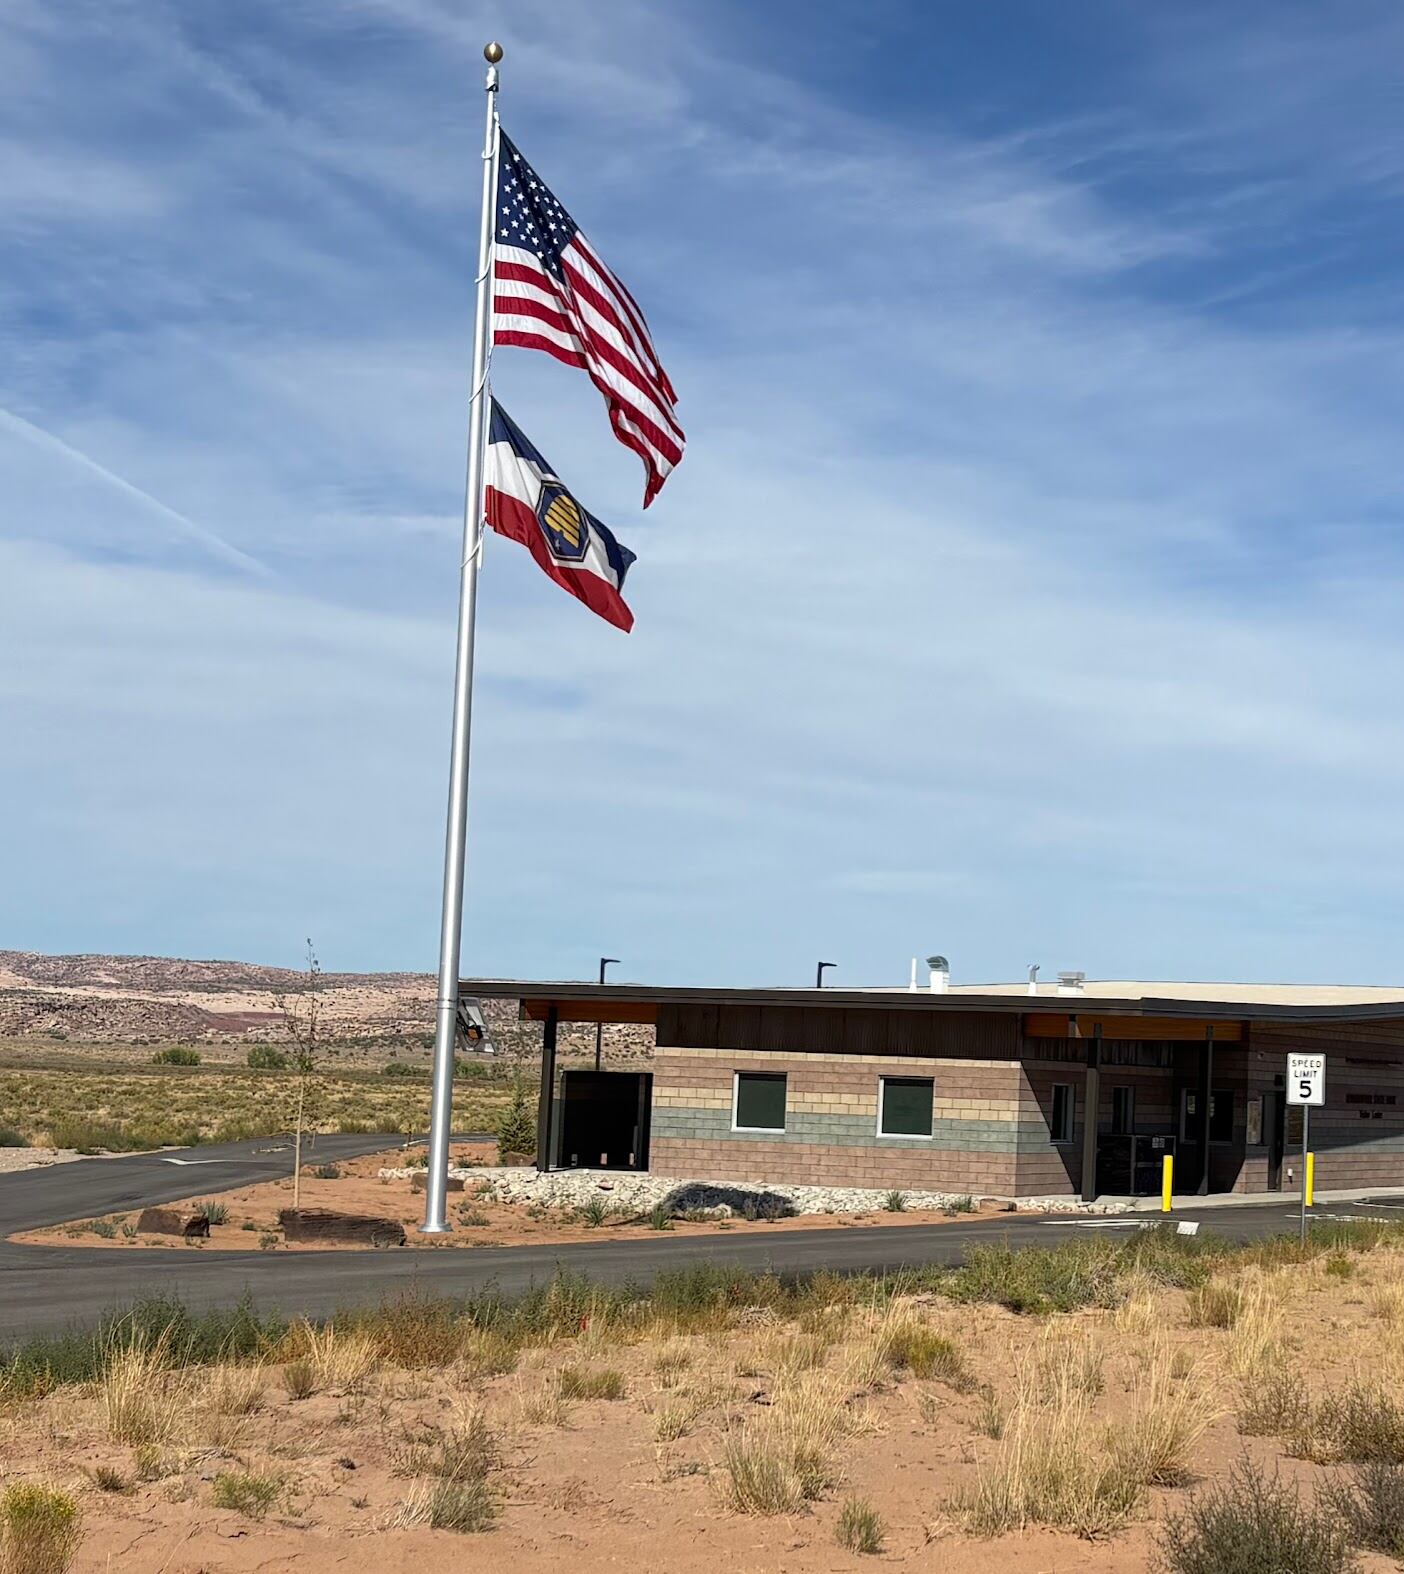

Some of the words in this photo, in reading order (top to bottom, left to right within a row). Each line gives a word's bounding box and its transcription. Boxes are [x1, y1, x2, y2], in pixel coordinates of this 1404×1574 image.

[1292, 1059, 1321, 1067] SPEED
[1294, 1070, 1317, 1078] LIMIT
[1299, 1080, 1311, 1098] 5
